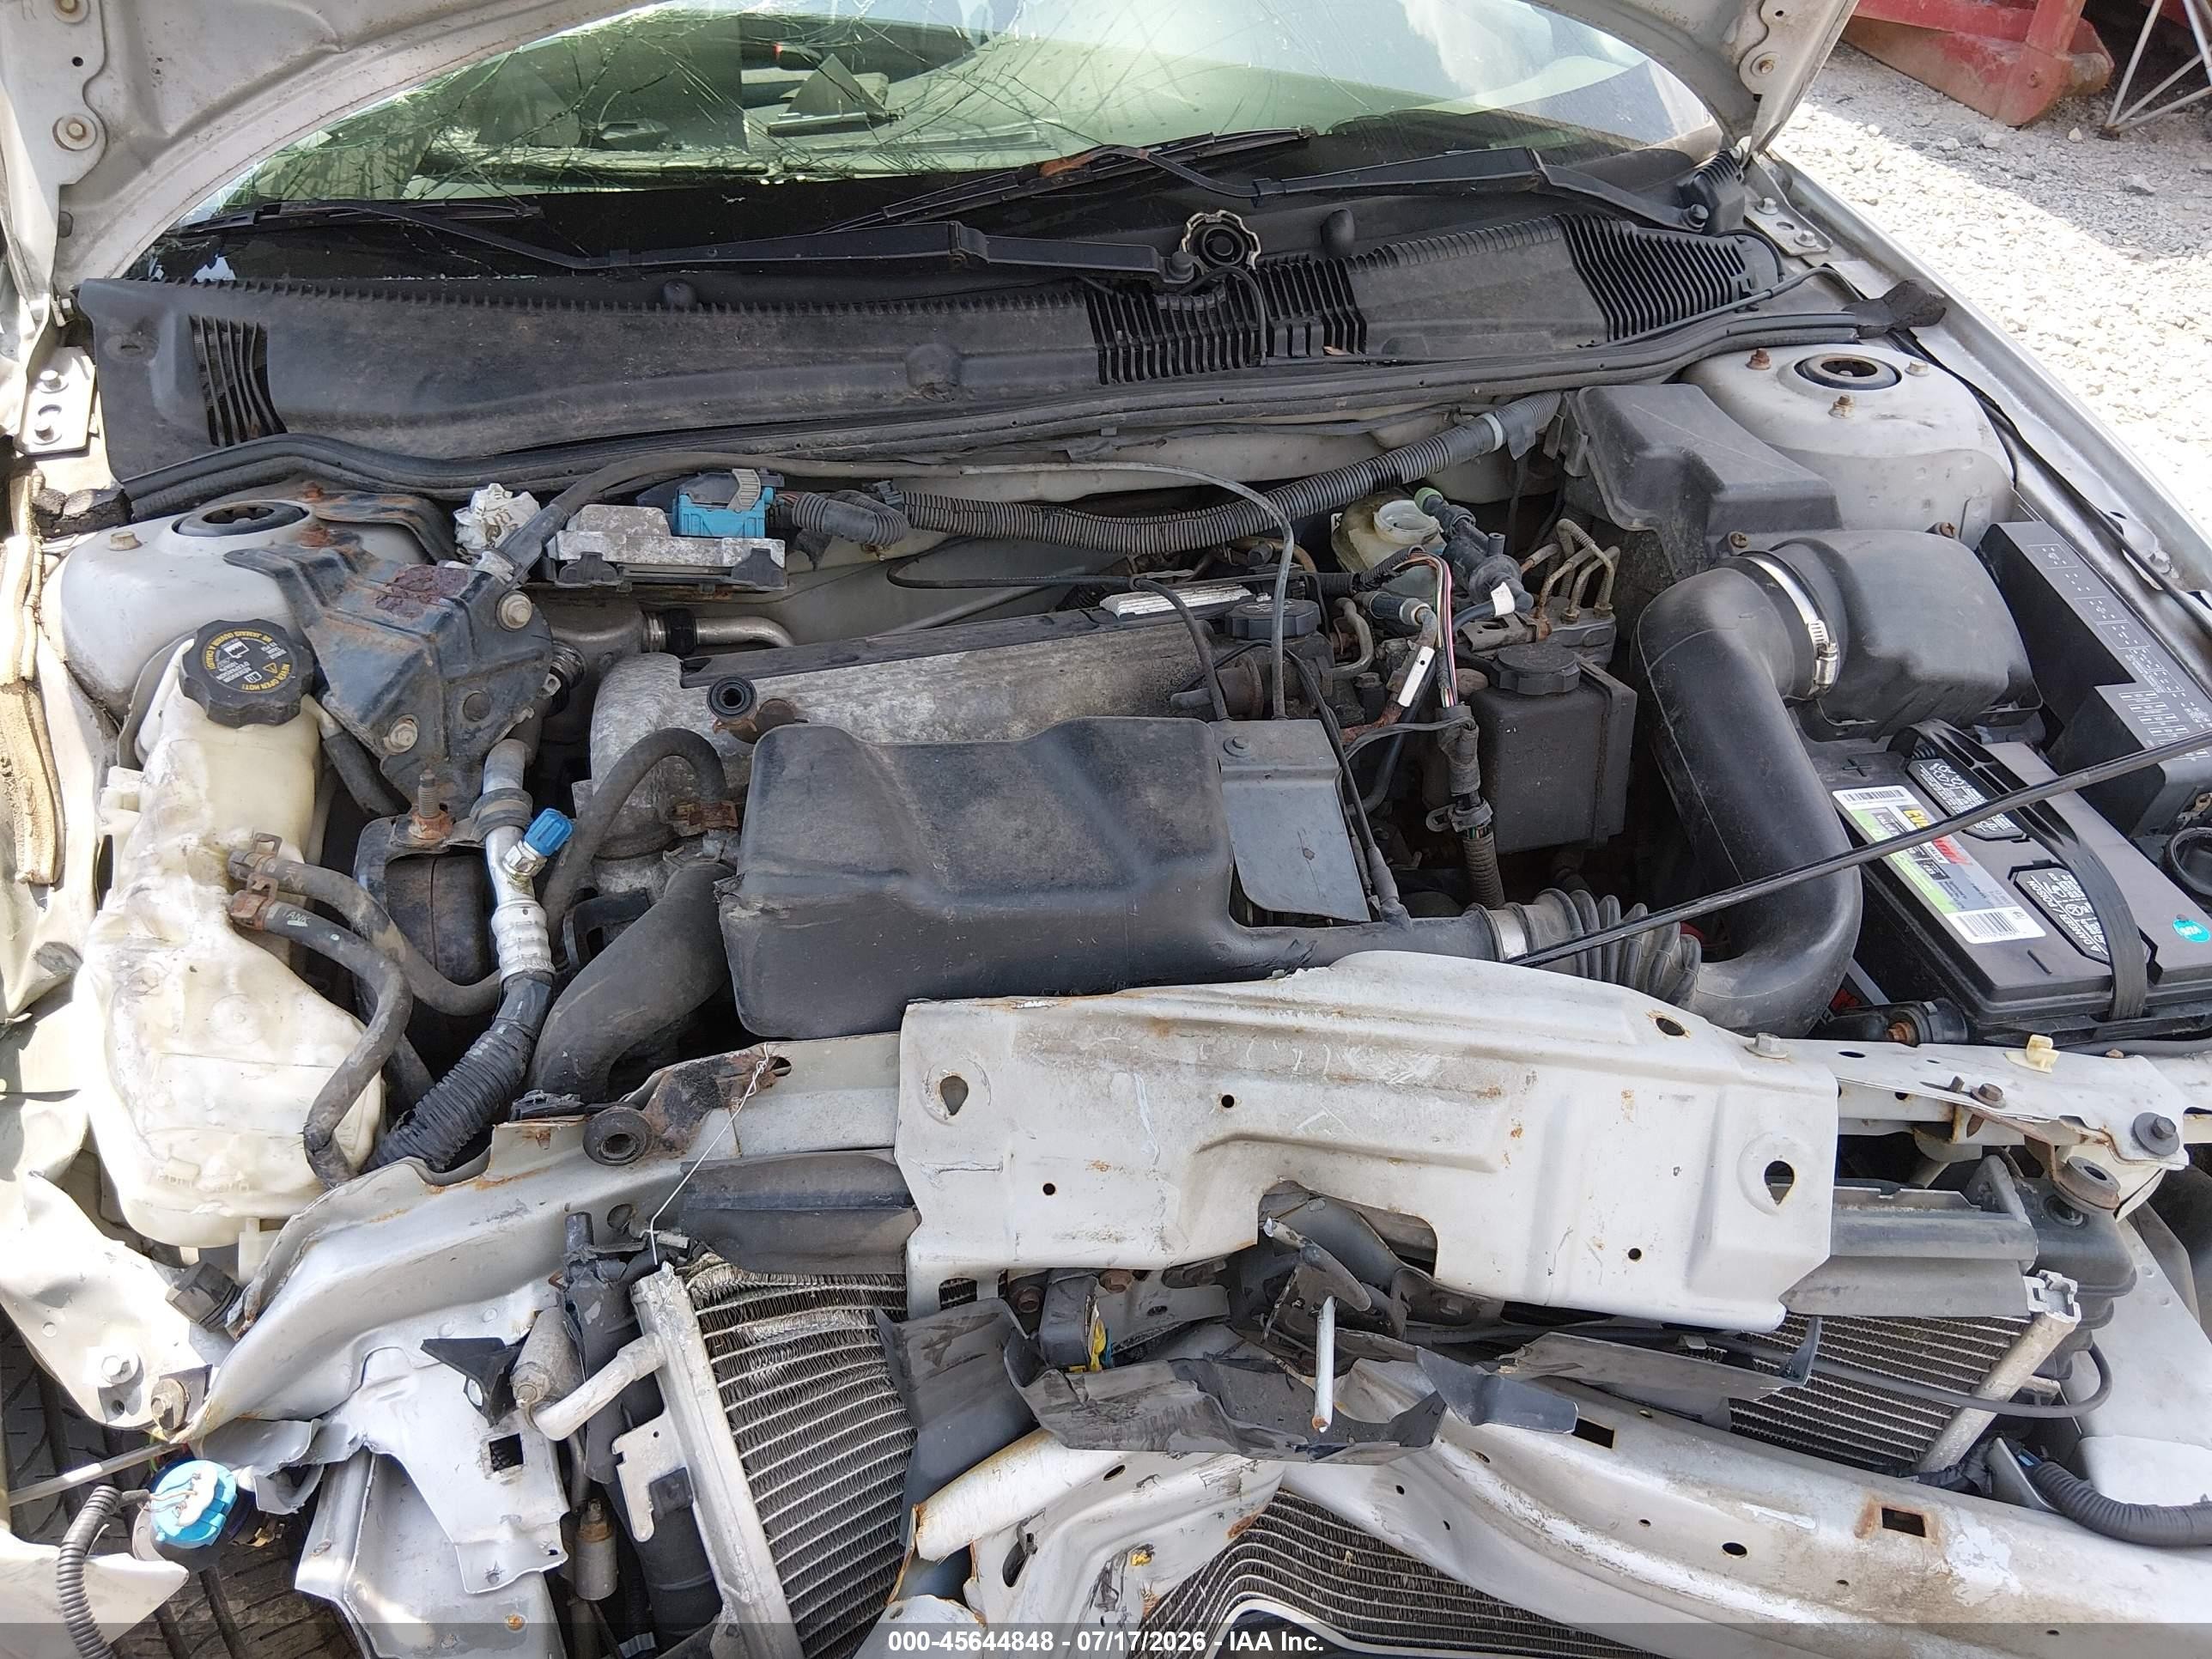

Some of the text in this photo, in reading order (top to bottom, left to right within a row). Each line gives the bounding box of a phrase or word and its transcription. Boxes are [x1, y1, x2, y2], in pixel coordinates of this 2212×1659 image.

[211, 632, 234, 647] OUVRIR
[275, 663, 290, 680] NEVER
[260, 678, 280, 690] OPEN
[2027, 880, 2057, 908] POISON
[2058, 914, 2094, 945] DANGER
